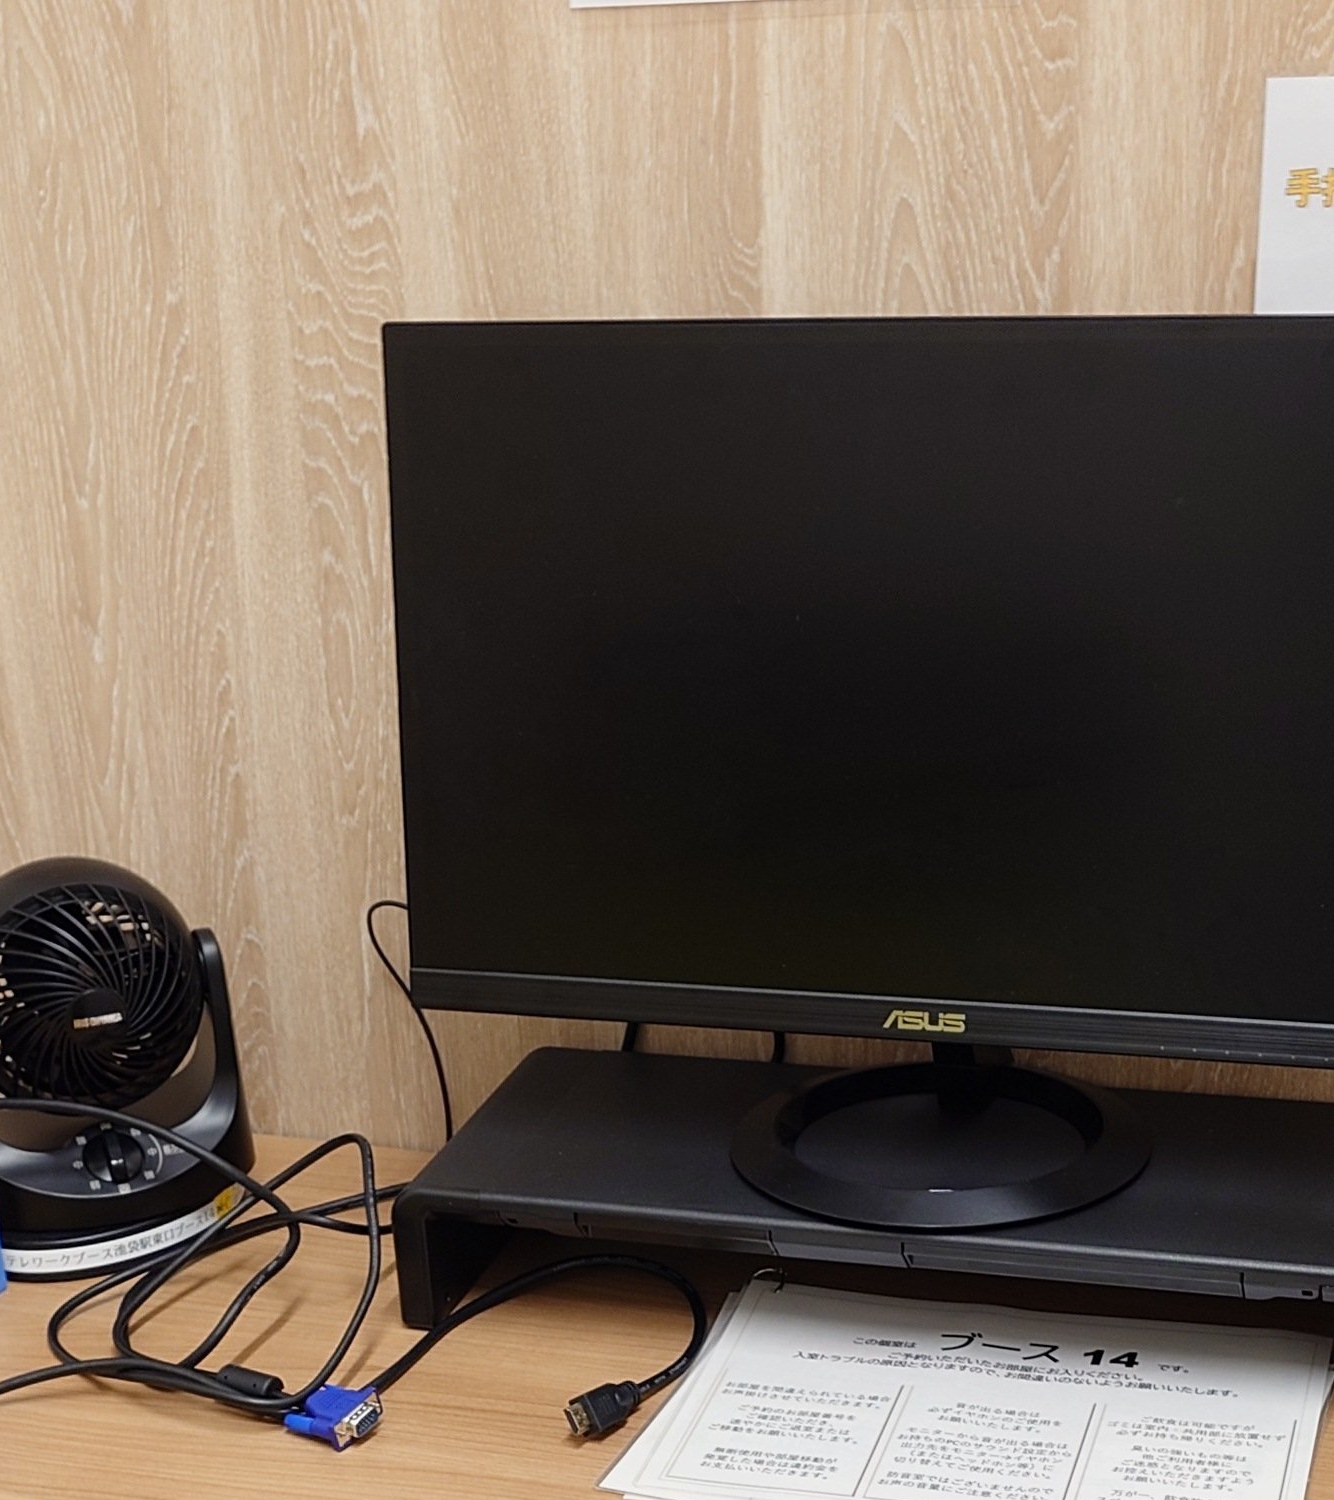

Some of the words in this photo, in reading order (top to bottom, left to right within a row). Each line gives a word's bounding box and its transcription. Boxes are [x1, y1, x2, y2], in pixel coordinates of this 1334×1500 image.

[882, 1010, 966, 1033] ASUS
[853, 1336, 917, 1348] この個室は
[941, 1332, 1061, 1364] ブース
[1083, 1351, 1140, 1369] 14
[1157, 1363, 1191, 1376] です。
[887, 1350, 1144, 1382] ご予約いただいたお部屋にお入りください。
[792, 1350, 1239, 1398] 入室トラブルの原因となりますので、お間違いのないようお願いいたします。
